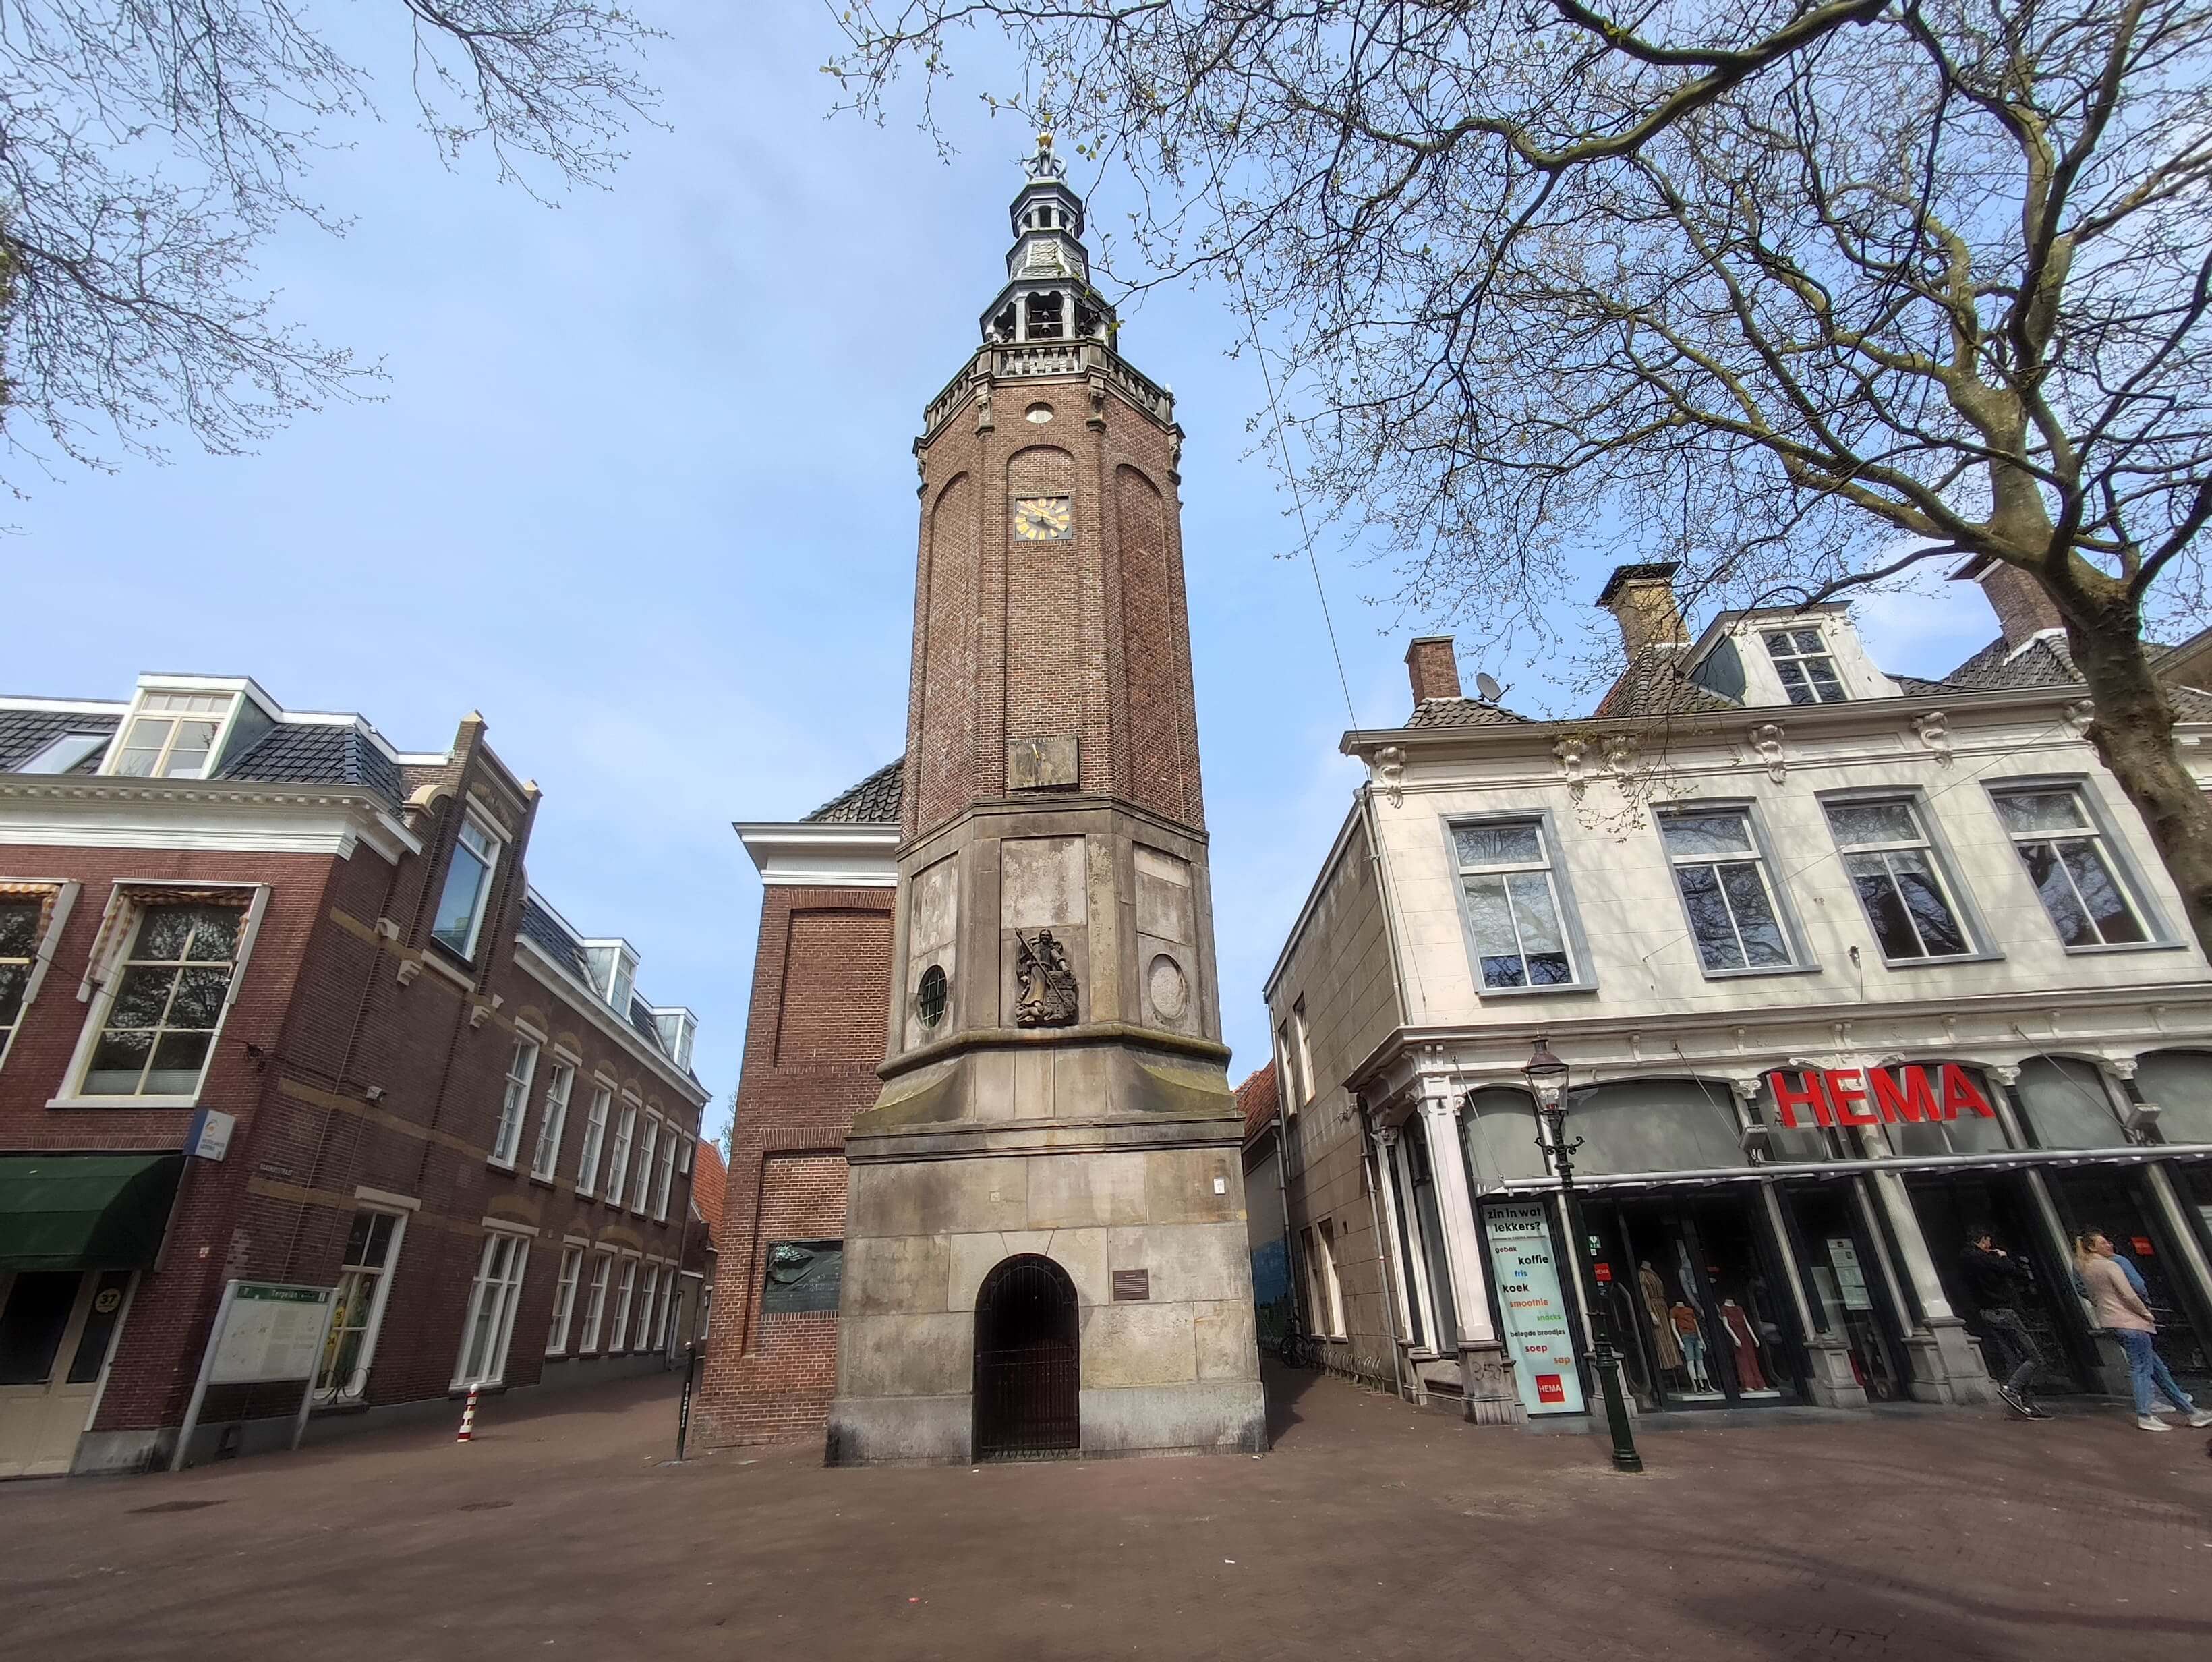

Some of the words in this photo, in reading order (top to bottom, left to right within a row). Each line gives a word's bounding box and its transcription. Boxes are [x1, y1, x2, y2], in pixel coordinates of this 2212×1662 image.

[1767, 1063, 1996, 1128] HEMA
[1487, 1209, 1504, 1219] zin
[1505, 1208, 1517, 1217] in
[1519, 1207, 1541, 1217] wat
[1494, 1222, 1540, 1232] lekkers?
[1518, 1255, 1548, 1265] koffie
[1503, 1283, 1529, 1293] koek
[101, 1294, 117, 1304] 37
[1510, 1298, 1548, 1307] smoothie
[1538, 1328, 1565, 1336] broodjes
[1525, 1345, 1548, 1353] soep
[1538, 1384, 1562, 1393] HEMA
